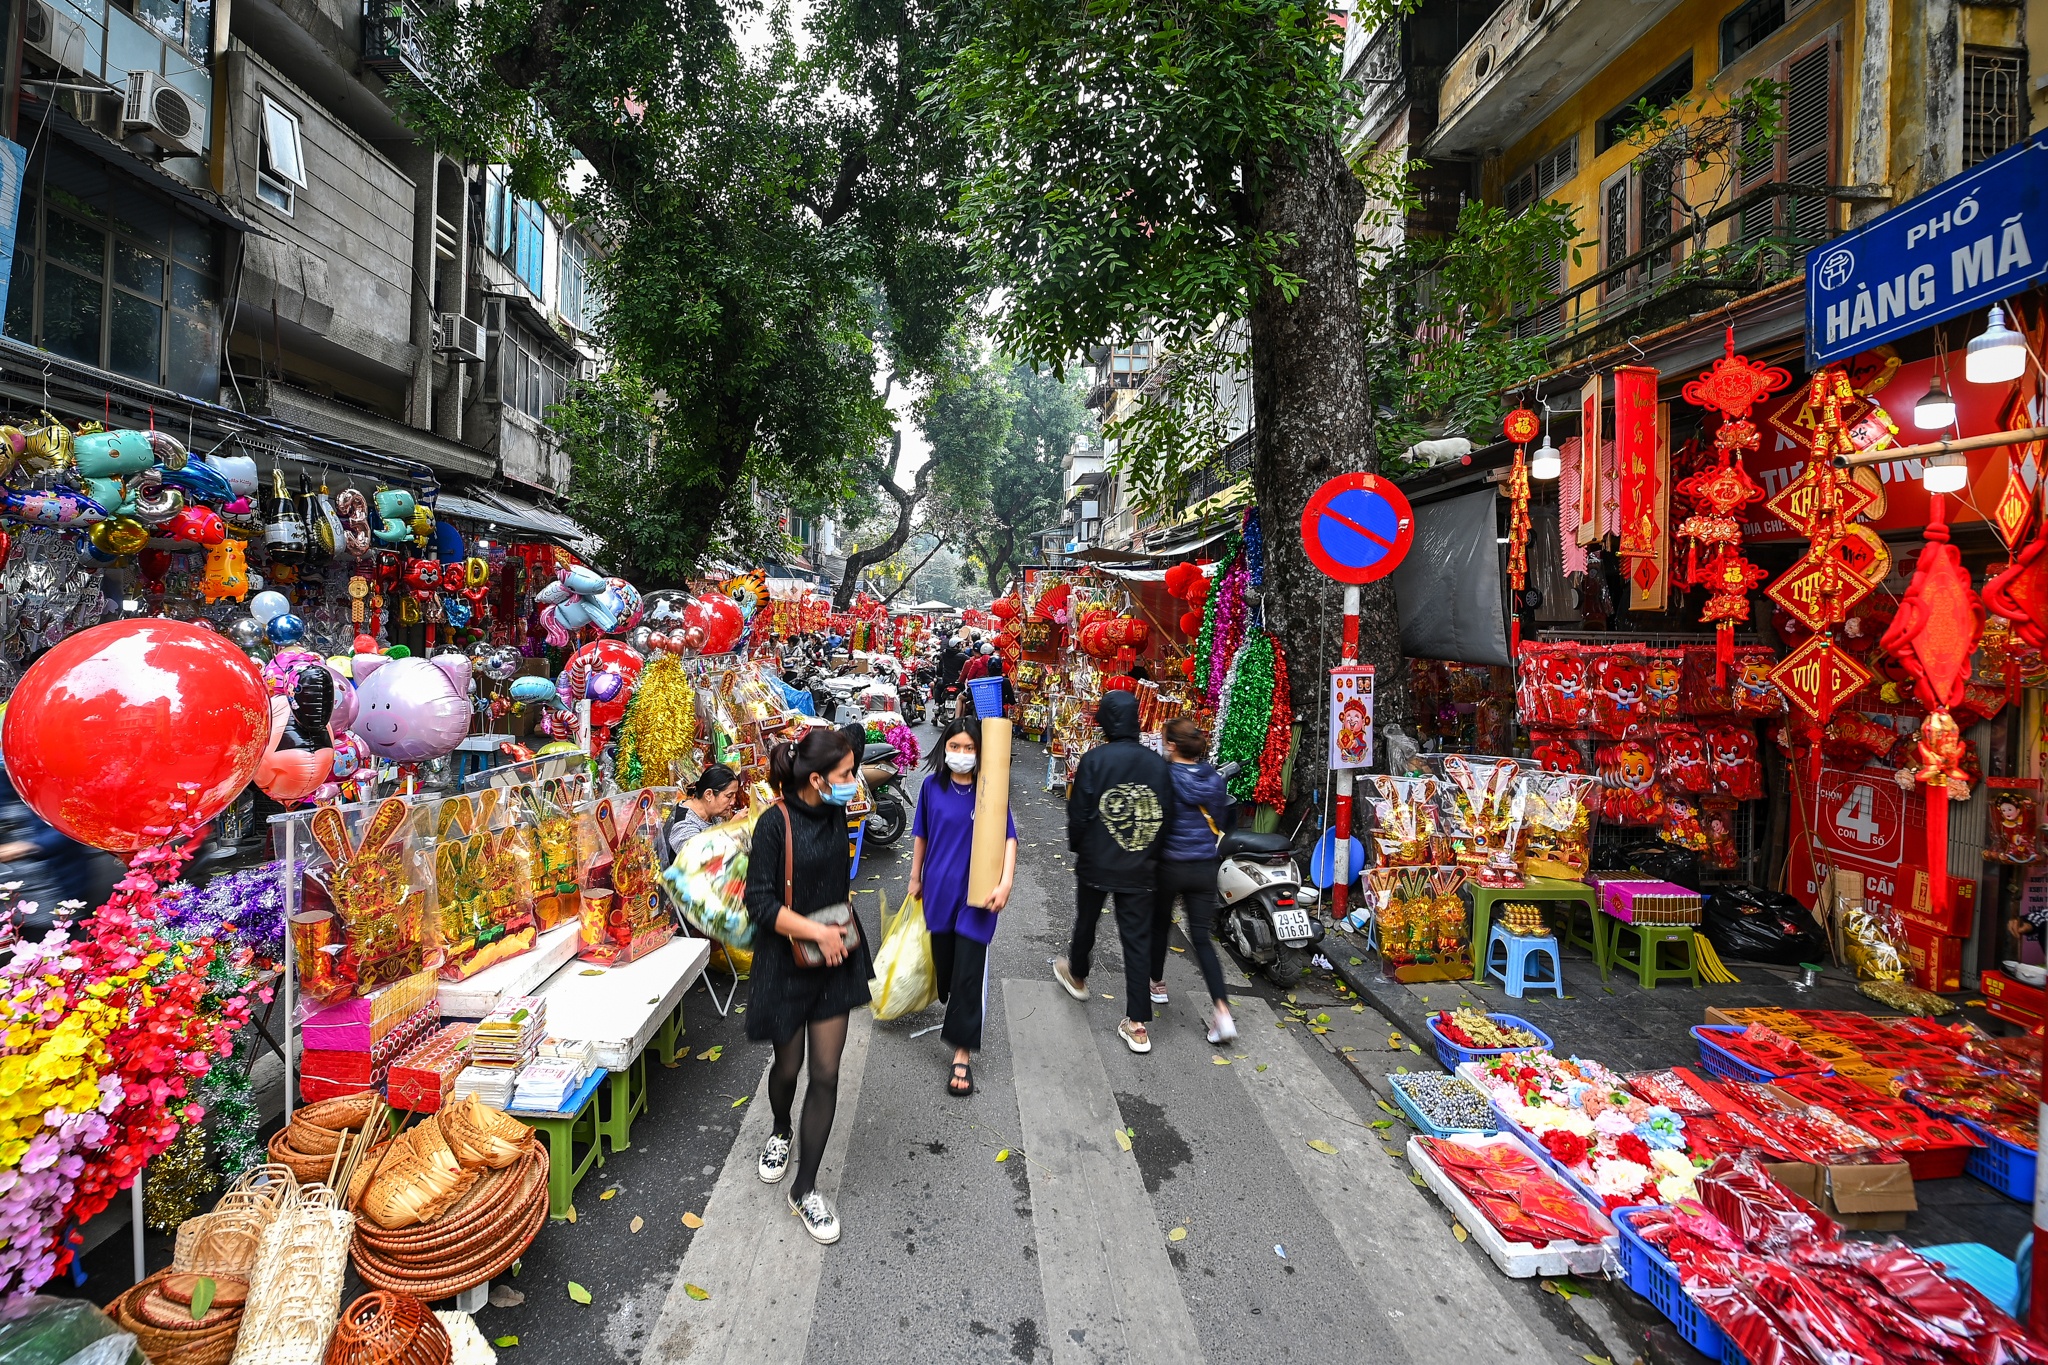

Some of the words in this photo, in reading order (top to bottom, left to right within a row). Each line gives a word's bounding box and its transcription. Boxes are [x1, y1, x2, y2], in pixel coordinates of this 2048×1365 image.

[1907, 187, 1981, 250] PHỐ
[1827, 263, 1935, 344] HÀNG
[1952, 212, 2032, 295] MÃ
[1514, 417, 1531, 434] 福
[1791, 486, 1844, 518] KHAG
[1791, 657, 1841, 704] VƯỢG
[1820, 789, 1842, 802] CHỌN
[1835, 785, 1880, 844] 4
[1837, 828, 1856, 840] CON
[1872, 834, 1885, 846] SỐ
[1278, 911, 1305, 926] 29-L5
[1278, 924, 1309, 939] 016.87
